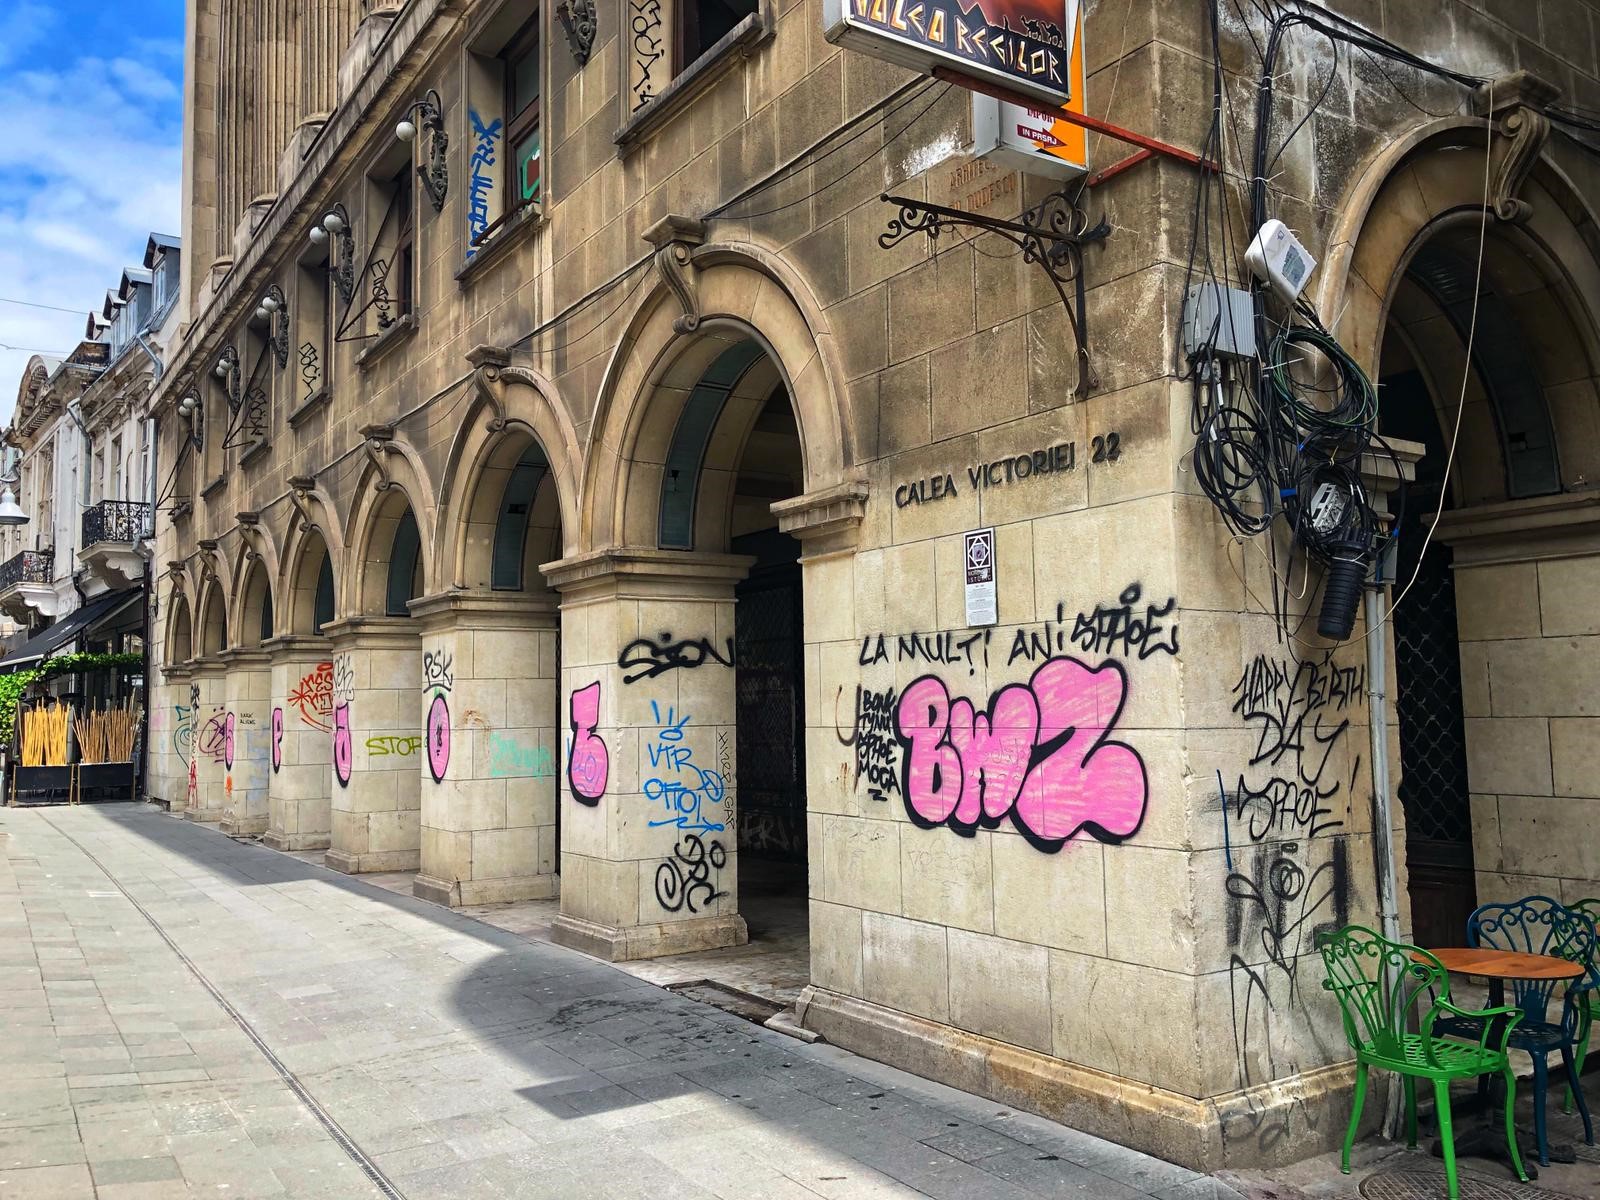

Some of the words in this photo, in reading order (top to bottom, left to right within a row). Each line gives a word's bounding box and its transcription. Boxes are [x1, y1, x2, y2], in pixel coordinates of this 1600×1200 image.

[956, 16, 1063, 84] REGILOR
[1022, 128, 1030, 137] IN
[895, 474, 957, 508] CALEA
[968, 442, 1075, 490] VICTORIEI
[1091, 432, 1121, 464] 22
[859, 633, 889, 666] LA
[1243, 711, 1350, 787] DAY
